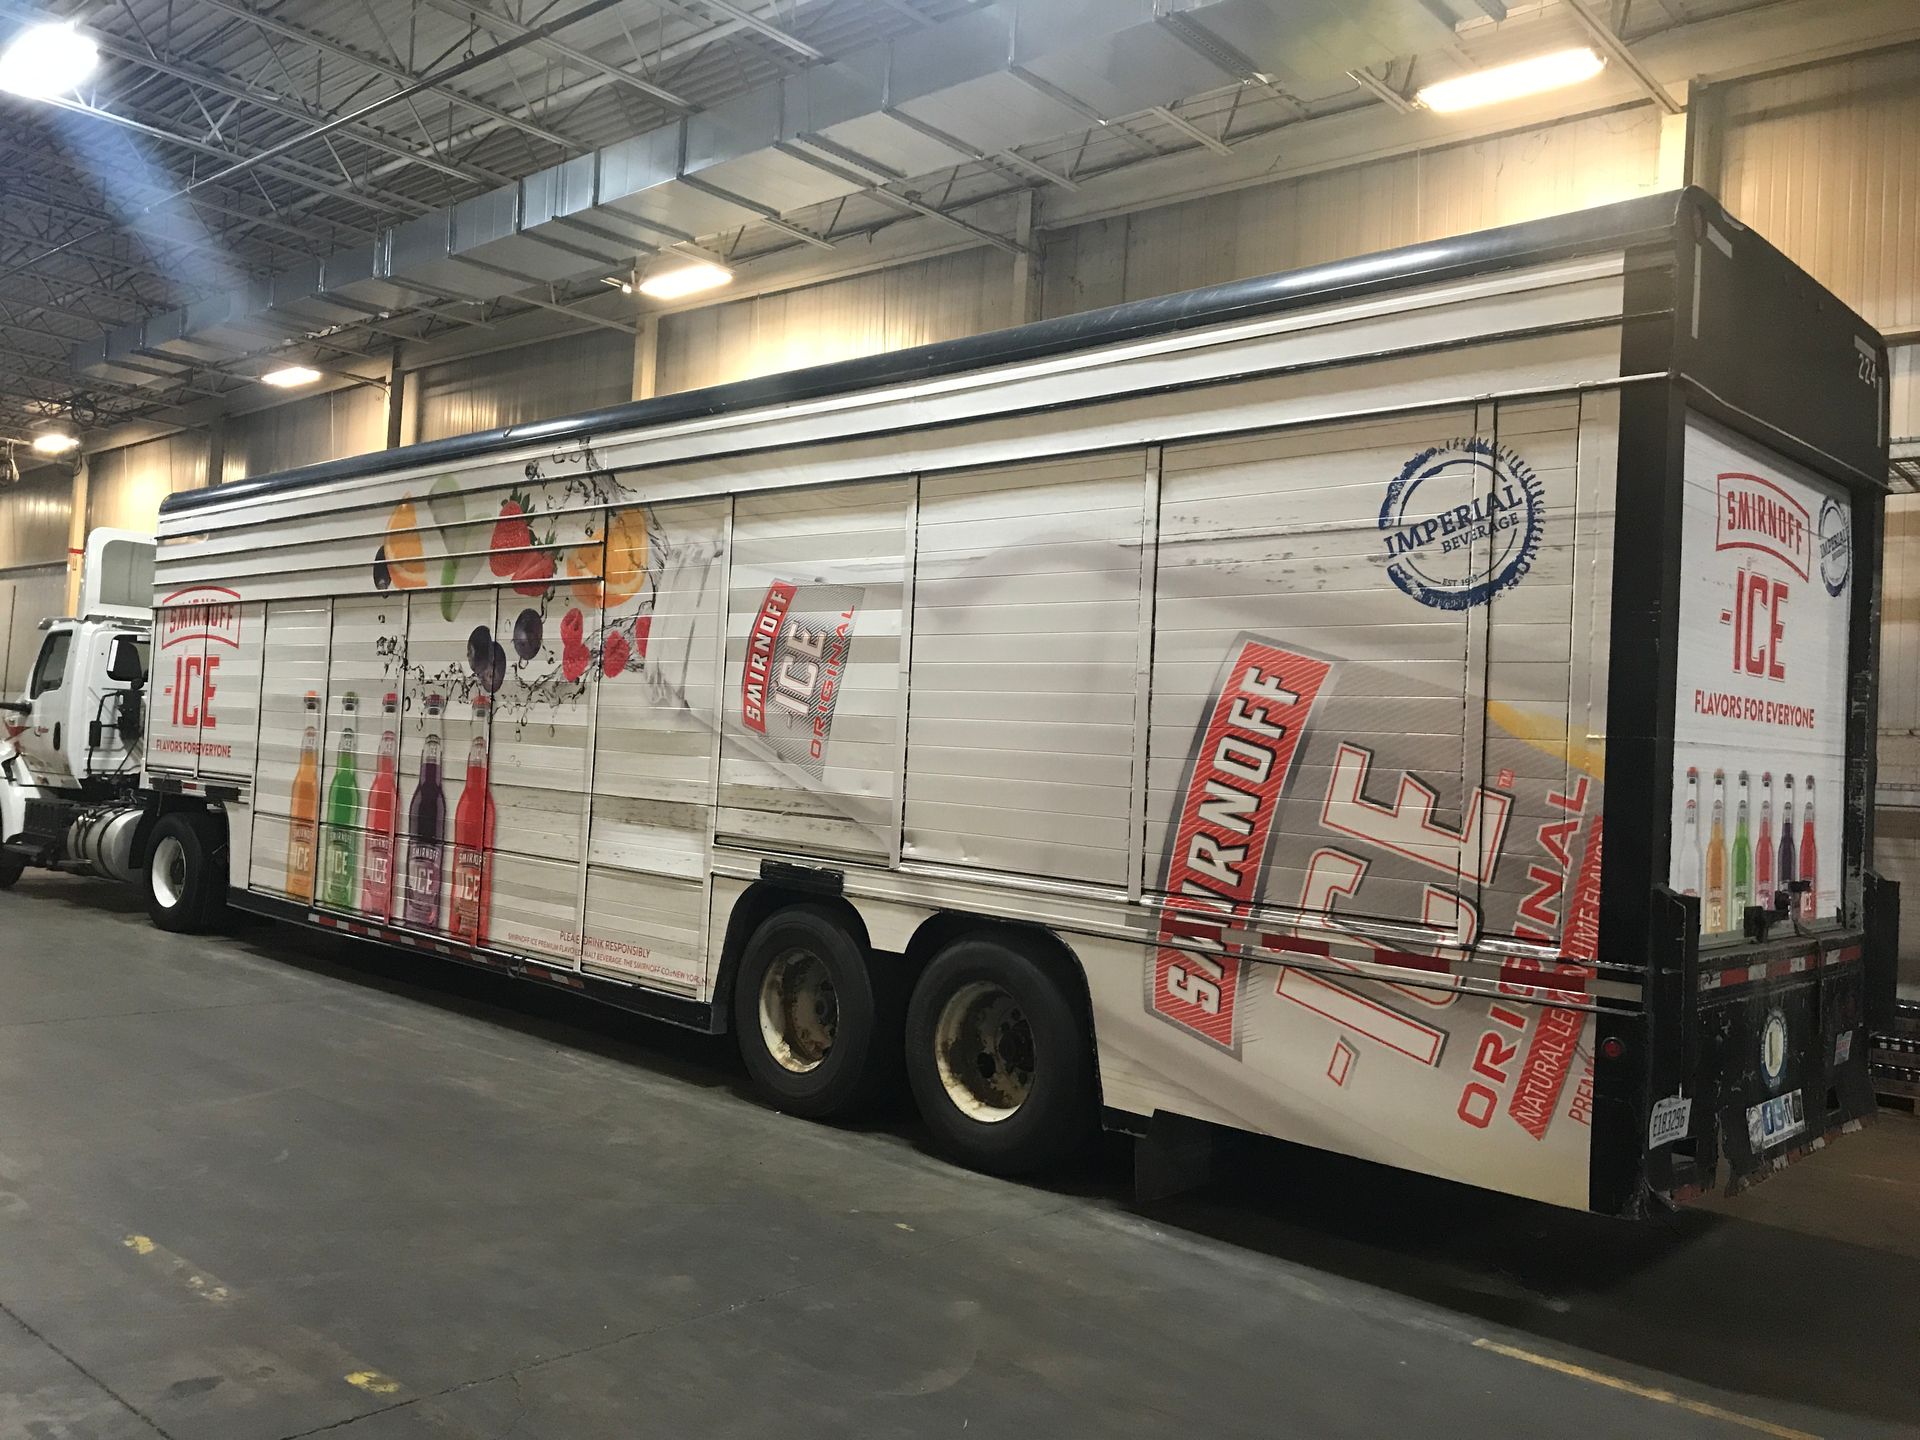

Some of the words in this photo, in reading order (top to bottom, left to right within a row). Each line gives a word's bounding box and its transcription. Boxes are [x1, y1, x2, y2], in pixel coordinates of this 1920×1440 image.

[1857, 352, 1877, 389] 224
[1383, 484, 1523, 560] IMPERIAL
[1441, 512, 1520, 554] BEVERAGE
[1727, 489, 1802, 556] SMIRNOFF
[169, 598, 234, 634] SMIRNOFF
[746, 590, 787, 722] SMIRNOFF
[774, 619, 828, 717] ICE
[810, 604, 854, 759] ORIGINAL
[1694, 689, 1742, 719] FLAVORS
[1744, 697, 1765, 722] FOR
[1766, 701, 1815, 729] EVERYONE
[156, 739, 182, 753] FLAVORS
[183, 741, 196, 754] FOR
[412, 846, 440, 862] SMIRNOFF
[458, 851, 487, 866] SMIRNOFF
[412, 866, 434, 895] ICE
[459, 873, 480, 902] ICE
[583, 936, 604, 949] DRINK
[606, 940, 651, 959] RESPONSIBLY
[1516, 1039, 1566, 1125] NATURAL
